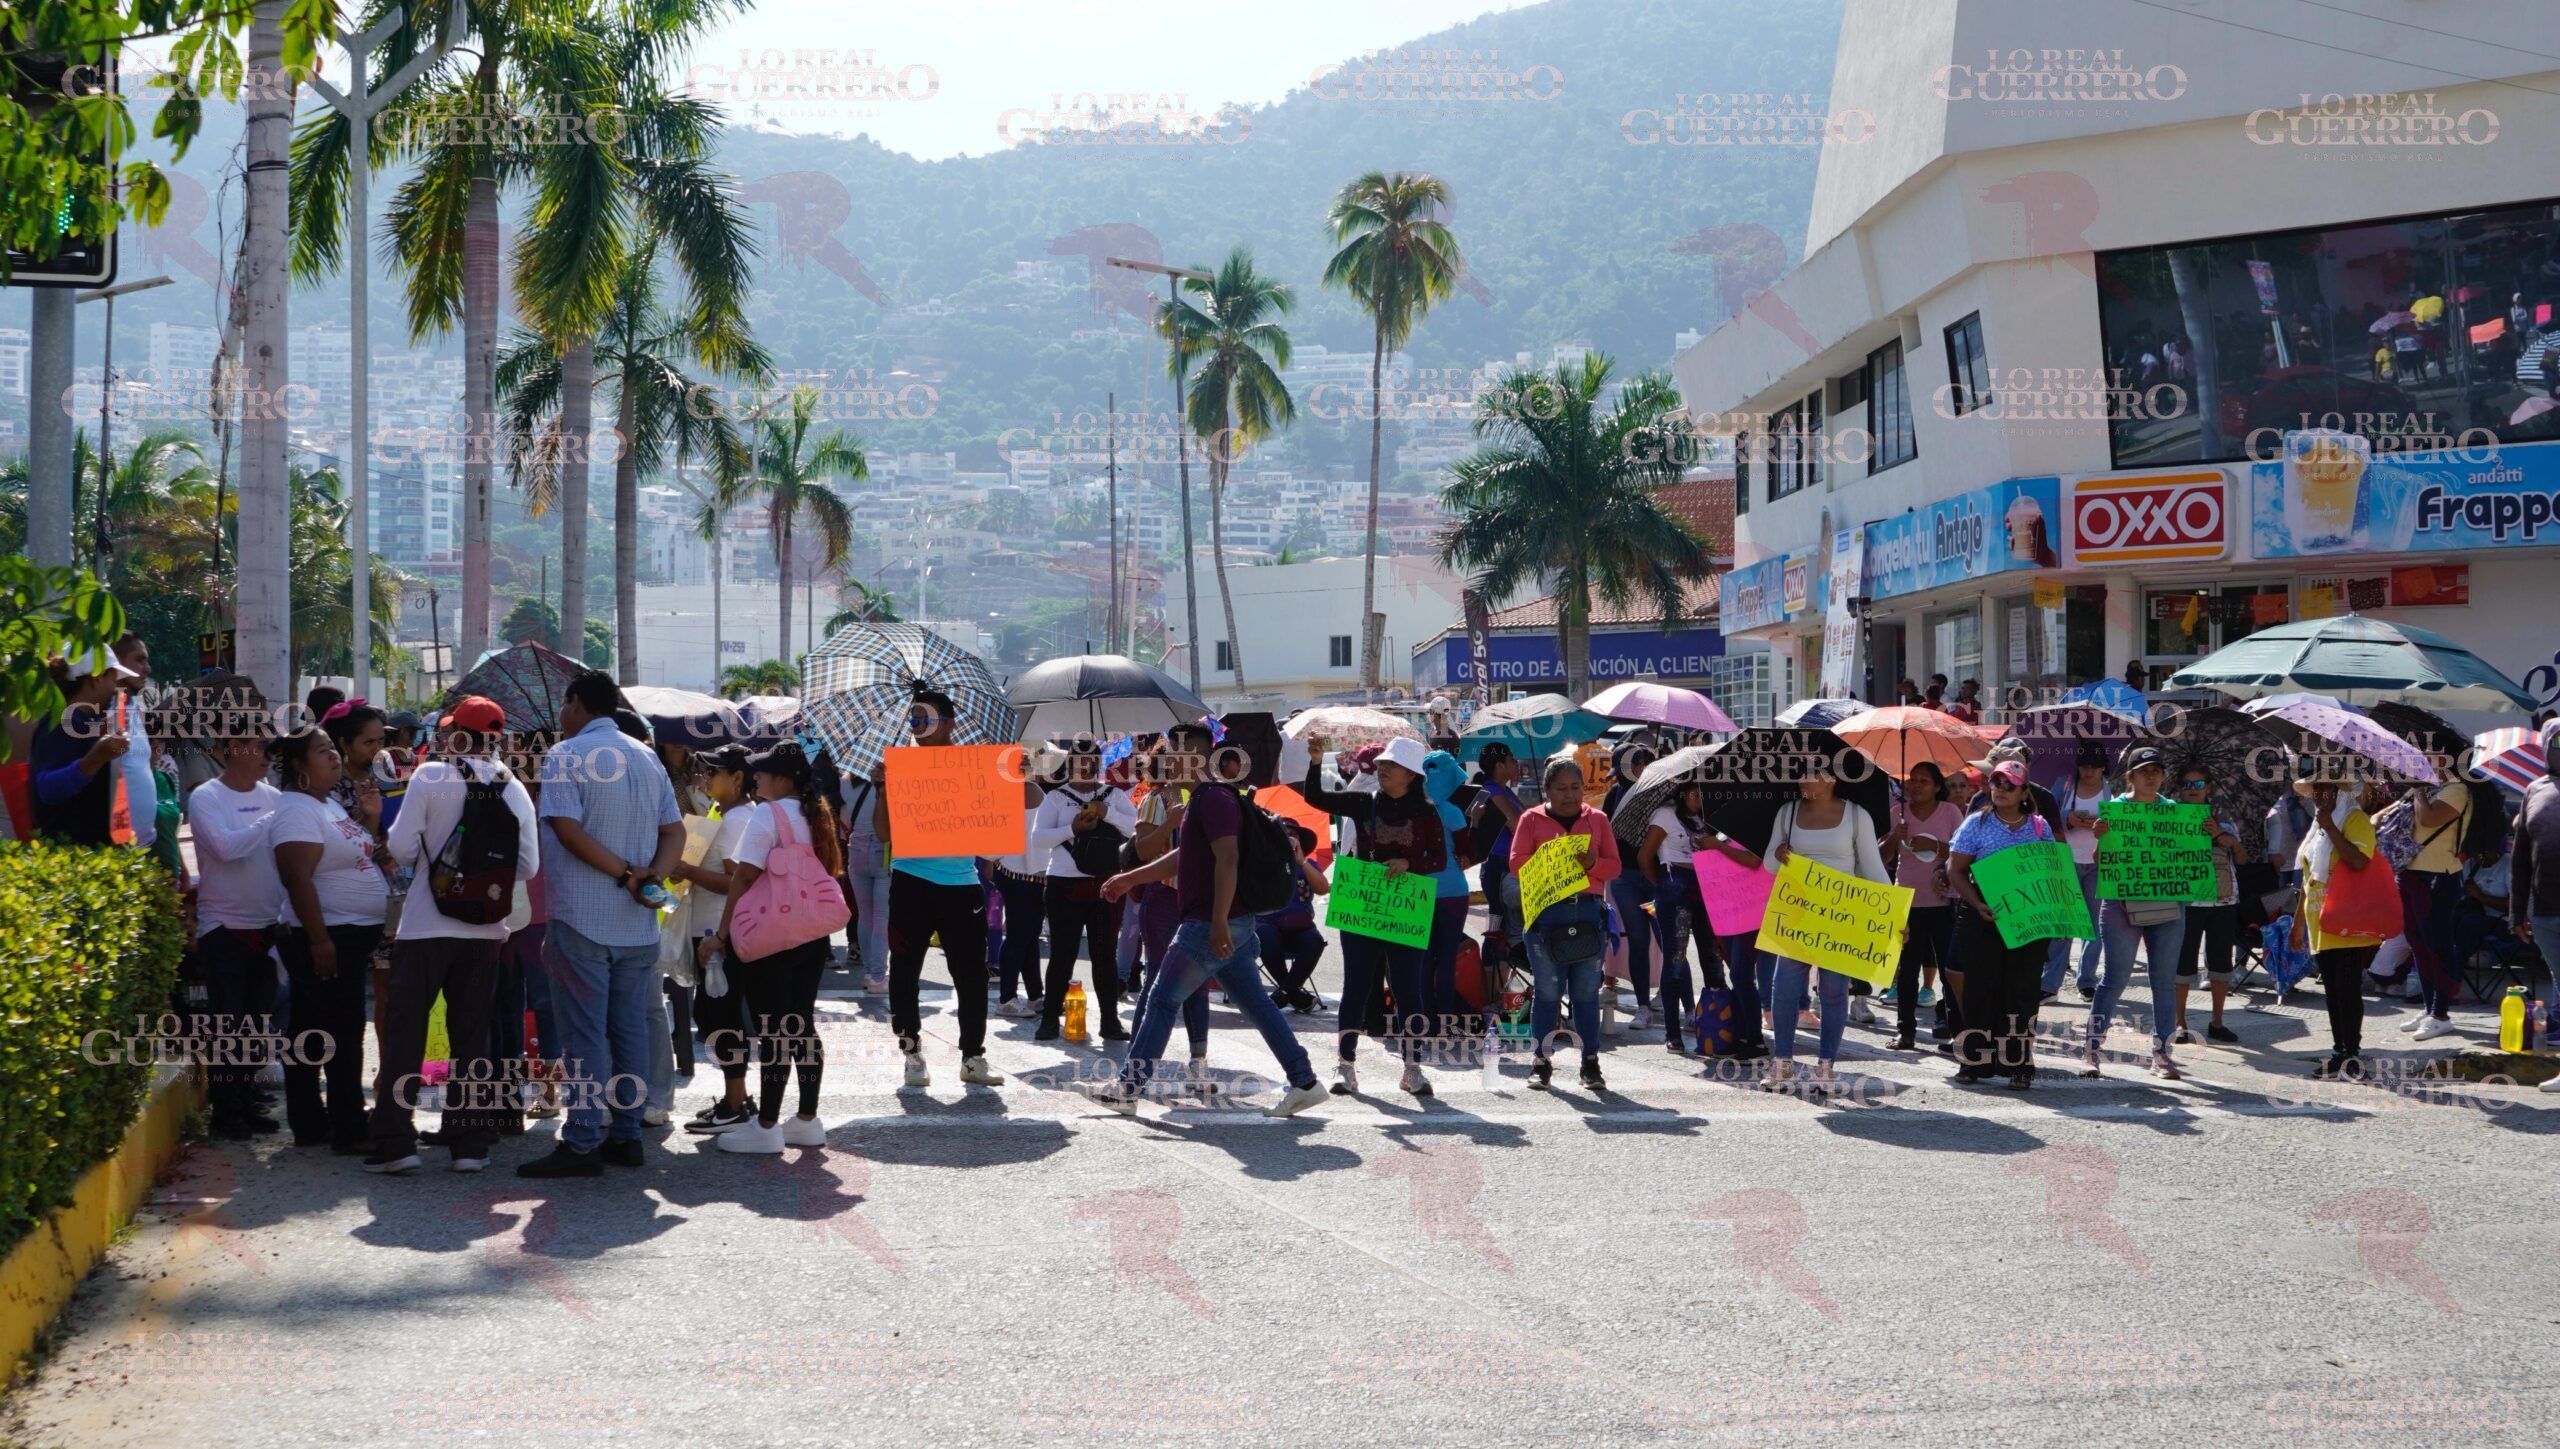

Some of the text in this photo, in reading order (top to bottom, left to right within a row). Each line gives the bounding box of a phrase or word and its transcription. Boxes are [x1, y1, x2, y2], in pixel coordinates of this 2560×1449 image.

[2468, 466, 2523, 484] andatti
[2078, 487, 2220, 547] OXXO
[1916, 519, 1931, 565] tu
[1936, 498, 1984, 574] Antojo
[1785, 565, 1805, 604] OXXO
[1528, 661, 1550, 678] DE
[1554, 654, 1640, 677] ANCIÓN
[1643, 658, 1656, 674] A
[2110, 818, 2147, 833] ARIANA
[2122, 834, 2144, 848] DEL
[2100, 850, 2133, 864] EXIGE
[2141, 850, 2156, 864] EL
[2100, 868, 2121, 882] TRO
[2127, 866, 2144, 880] DE
[1804, 861, 1891, 916] Exigimos
[1331, 911, 1426, 938] TRANSFORMADOR
